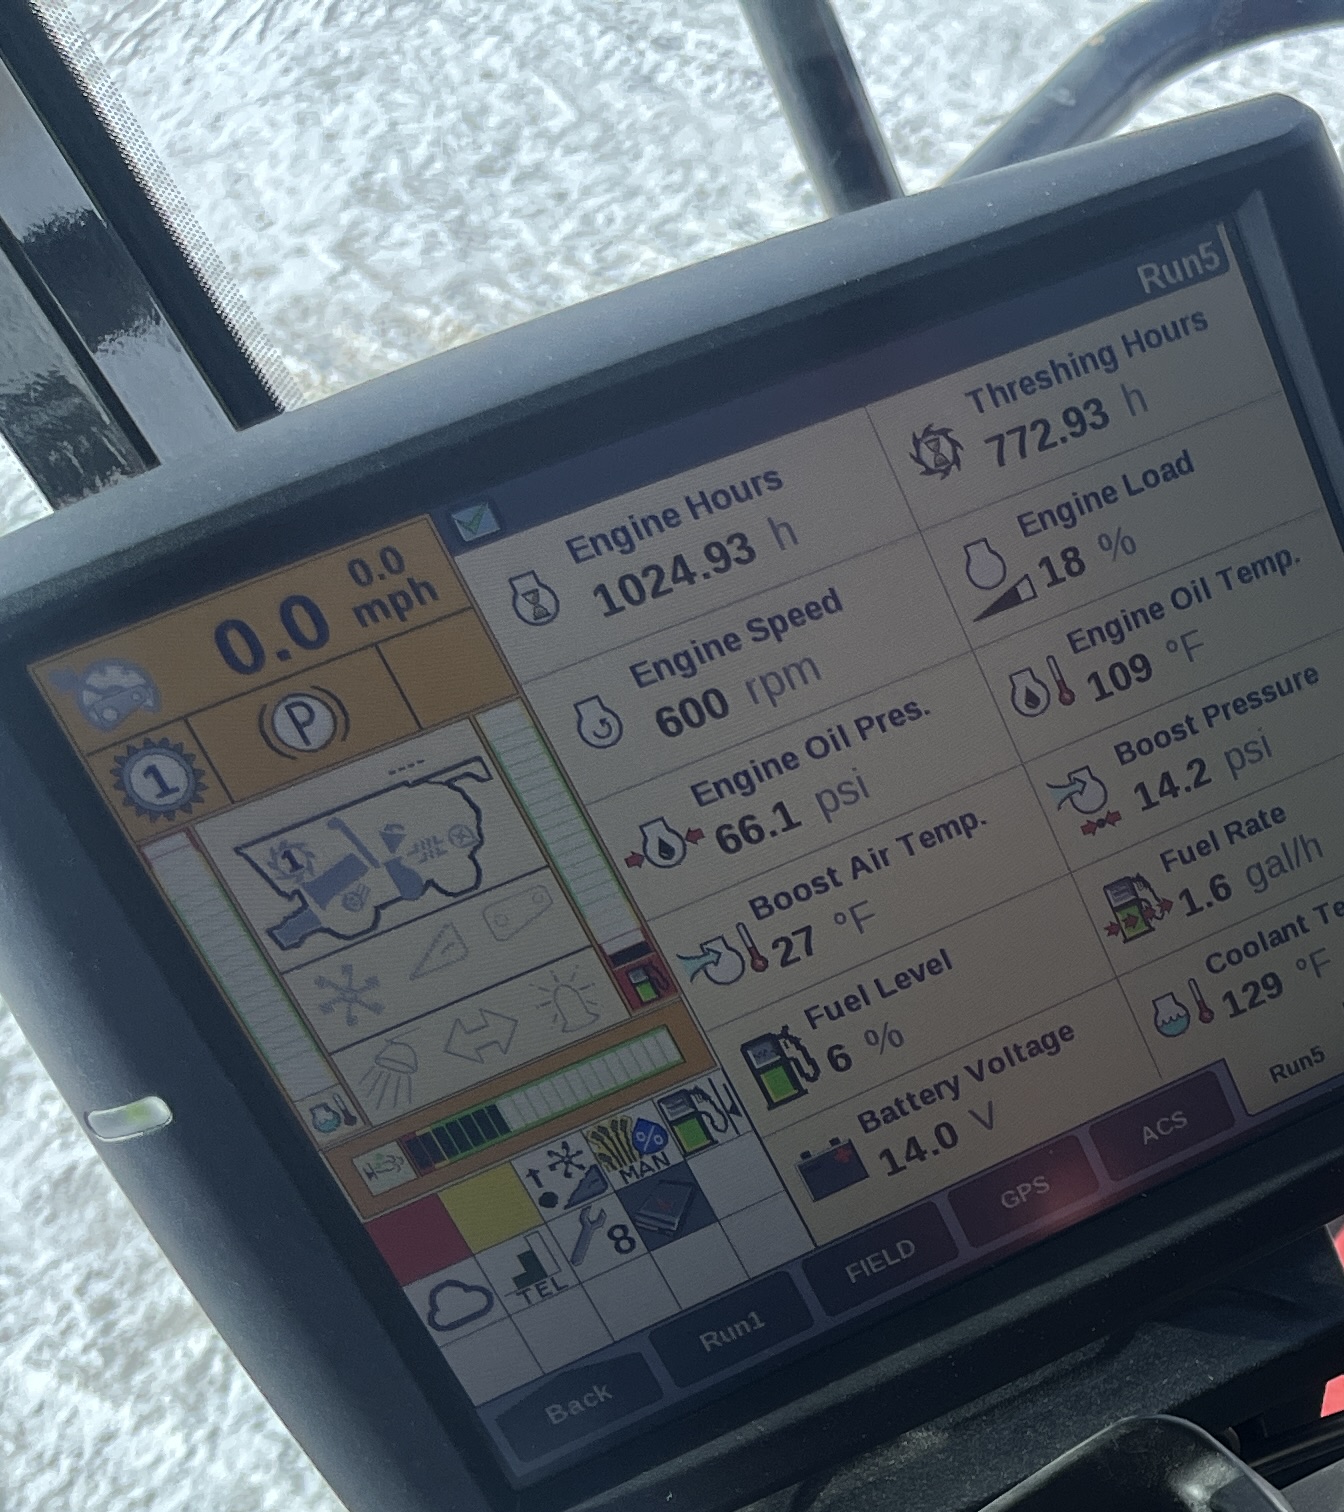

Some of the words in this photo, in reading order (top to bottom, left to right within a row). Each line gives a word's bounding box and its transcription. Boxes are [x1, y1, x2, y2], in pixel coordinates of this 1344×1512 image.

[1136, 241, 1222, 294] Run5
[964, 342, 1119, 418] Threshing
[1121, 307, 1209, 359] Hours
[984, 397, 1111, 469] 772.93
[1119, 382, 1149, 418] h
[565, 504, 682, 564] Engine
[685, 469, 783, 524] Hours
[1017, 481, 1118, 539] Engine
[1121, 450, 1195, 498] Load
[347, 545, 406, 589] 0.0
[593, 532, 756, 618] 1024.93
[767, 516, 798, 551] h
[1037, 546, 1086, 591] 18
[1098, 527, 1138, 559] %
[214, 594, 330, 675] 0.0
[352, 576, 439, 629] mph
[1067, 599, 1166, 656] Engine
[1169, 575, 1211, 611] Oil
[1216, 546, 1301, 595] Temp.
[629, 628, 742, 688] Engine
[746, 587, 844, 644] Speed
[1086, 651, 1153, 704] 109
[1164, 631, 1205, 666] °F
[656, 687, 730, 737] 600
[744, 656, 822, 708] rpm
[1114, 713, 1199, 766] Boost
[1201, 665, 1320, 729] Pressure
[142, 762, 177, 800] 1
[690, 750, 799, 807] Engine
[805, 723, 851, 759] Oil
[854, 698, 930, 742] Pres.
[1133, 758, 1212, 812] 14.2
[1223, 727, 1273, 780] psi
[716, 801, 801, 854] 66.1
[814, 768, 870, 824] psi
[1160, 832, 1219, 872] Fuel
[1223, 806, 1287, 844] Rate
[749, 866, 843, 921] Boost
[850, 846, 891, 880] Air
[897, 813, 987, 858] Temp.
[1178, 874, 1233, 917] 1.6
[1245, 832, 1325, 894] gal/h
[771, 925, 817, 968] 27
[834, 899, 876, 935] °F
[1205, 913, 1310, 975] Coolant
[804, 984, 870, 1030] Fuel
[874, 948, 953, 999] Level
[1222, 971, 1285, 1019] 129
[1295, 948, 1333, 978] °F
[827, 1043, 852, 1072] 6
[864, 1023, 905, 1055] %
[857, 1073, 963, 1133] Battery
[964, 1023, 1075, 1084] Voltage
[1270, 1045, 1326, 1083] Run5
[878, 1121, 959, 1178] 14.0
[968, 1101, 995, 1131] V
[1142, 1111, 1188, 1145] ACS
[619, 1152, 671, 1184] MAN
[1000, 1175, 1050, 1211] GPS
[608, 1225, 636, 1254] 8
[845, 1238, 916, 1284] FIELD
[516, 1277, 569, 1304] TEL
[699, 1310, 766, 1353] Run1
[544, 1382, 613, 1426] Back
